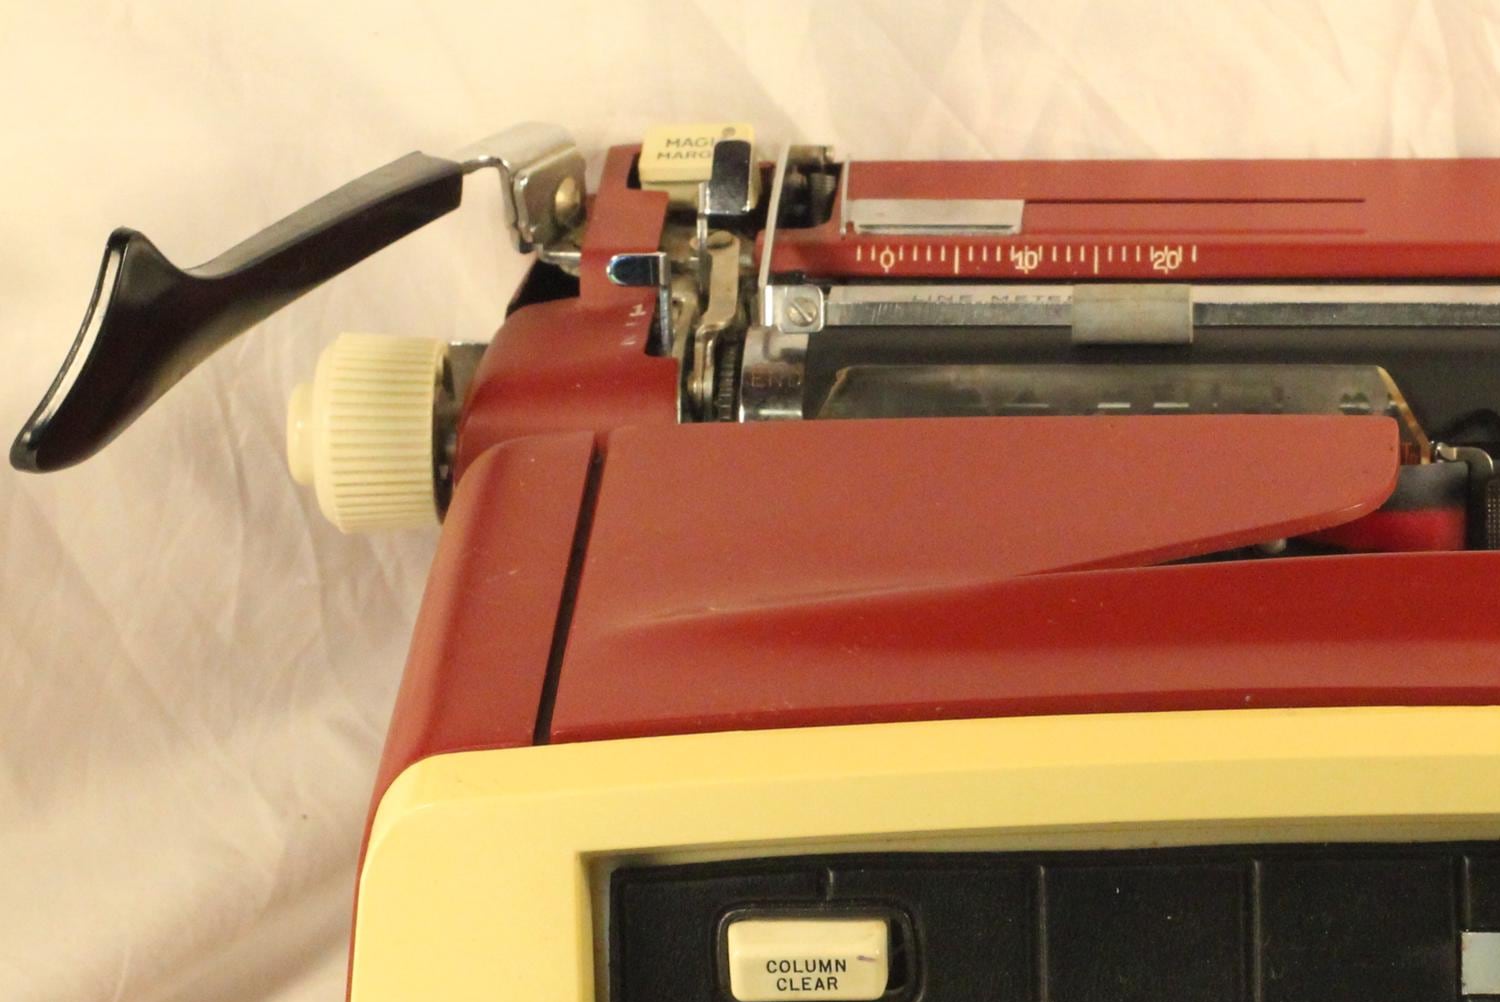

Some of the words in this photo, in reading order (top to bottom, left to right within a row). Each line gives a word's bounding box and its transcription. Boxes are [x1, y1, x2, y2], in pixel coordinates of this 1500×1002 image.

[665, 137, 715, 148] MAGI
[766, 959, 847, 974] COLUMN
[776, 976, 838, 992] CLEAR
